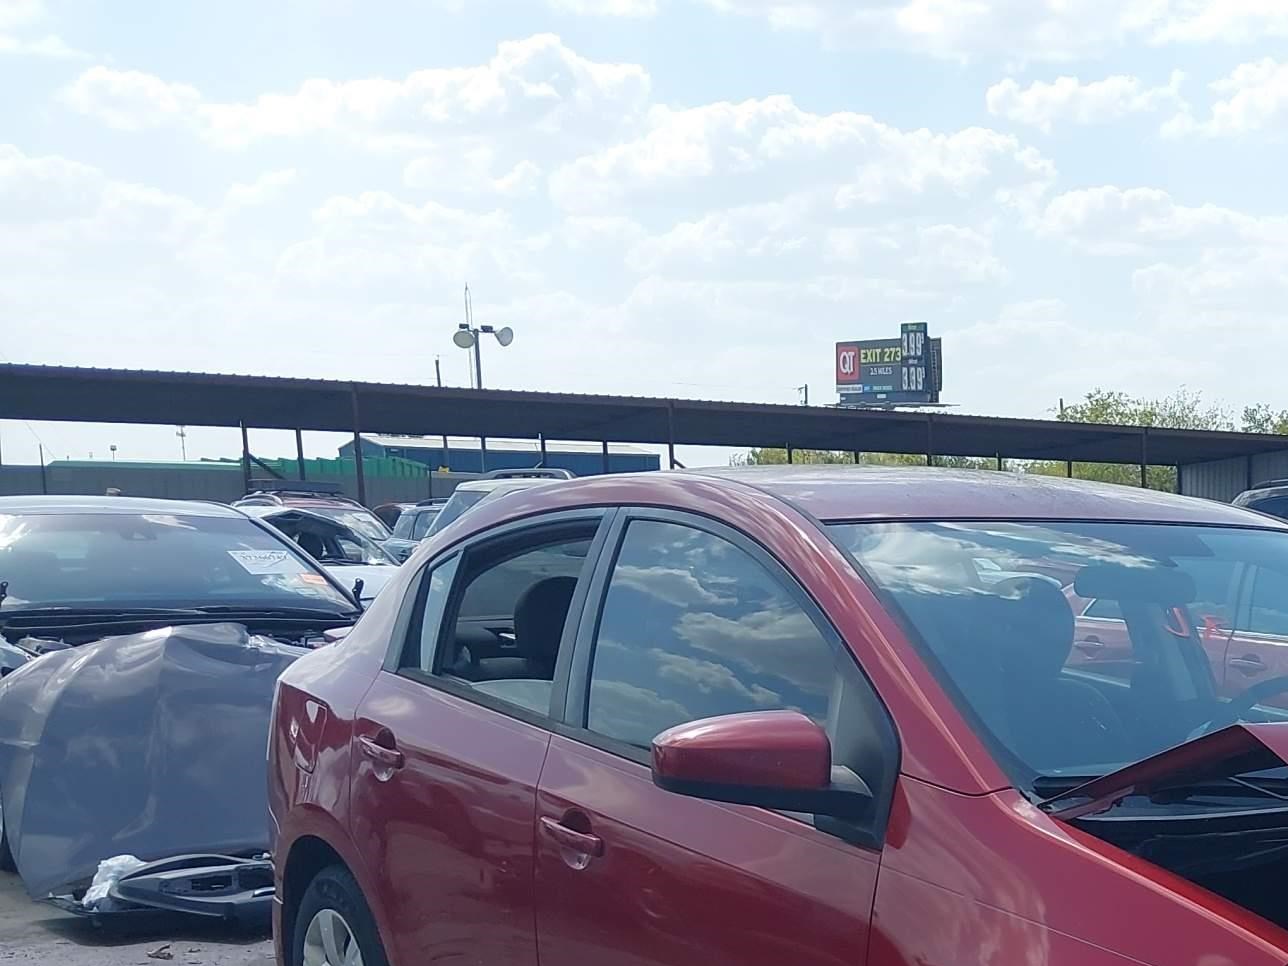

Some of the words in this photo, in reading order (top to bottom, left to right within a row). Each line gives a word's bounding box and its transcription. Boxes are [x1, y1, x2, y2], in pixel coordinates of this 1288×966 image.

[840, 351, 855, 374] QT
[860, 348, 881, 363] EXIT
[883, 347, 902, 362] 273
